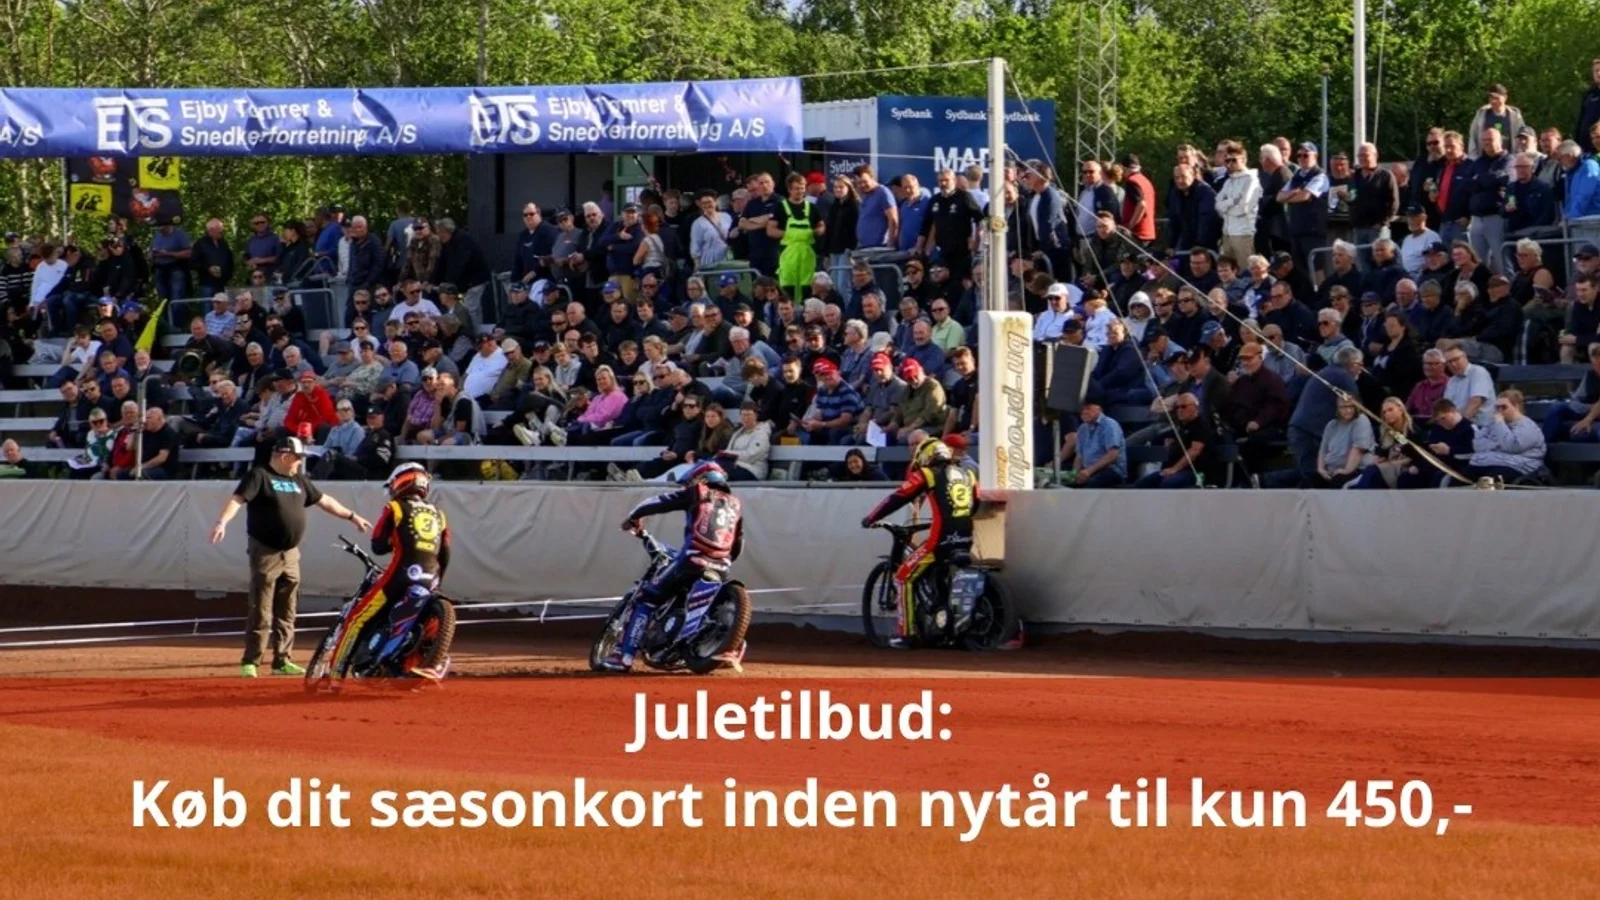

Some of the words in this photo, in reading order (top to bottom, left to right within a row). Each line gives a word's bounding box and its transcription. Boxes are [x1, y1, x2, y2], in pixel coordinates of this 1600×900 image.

[180, 100, 228, 124] Ejby
[316, 98, 332, 118] &
[548, 97, 591, 120] Ejby
[891, 107, 933, 120] Sydbank
[945, 108, 987, 123] Sydbank
[1003, 111, 1041, 123] ydbank
[180, 125, 369, 146] Snedkerforretning
[376, 124, 417, 147] A/S
[729, 117, 765, 139] A/S
[829, 158, 866, 176] Sydba
[1001, 330, 1030, 490] bn-produ
[956, 487, 966, 501] 2
[421, 517, 434, 533] 3
